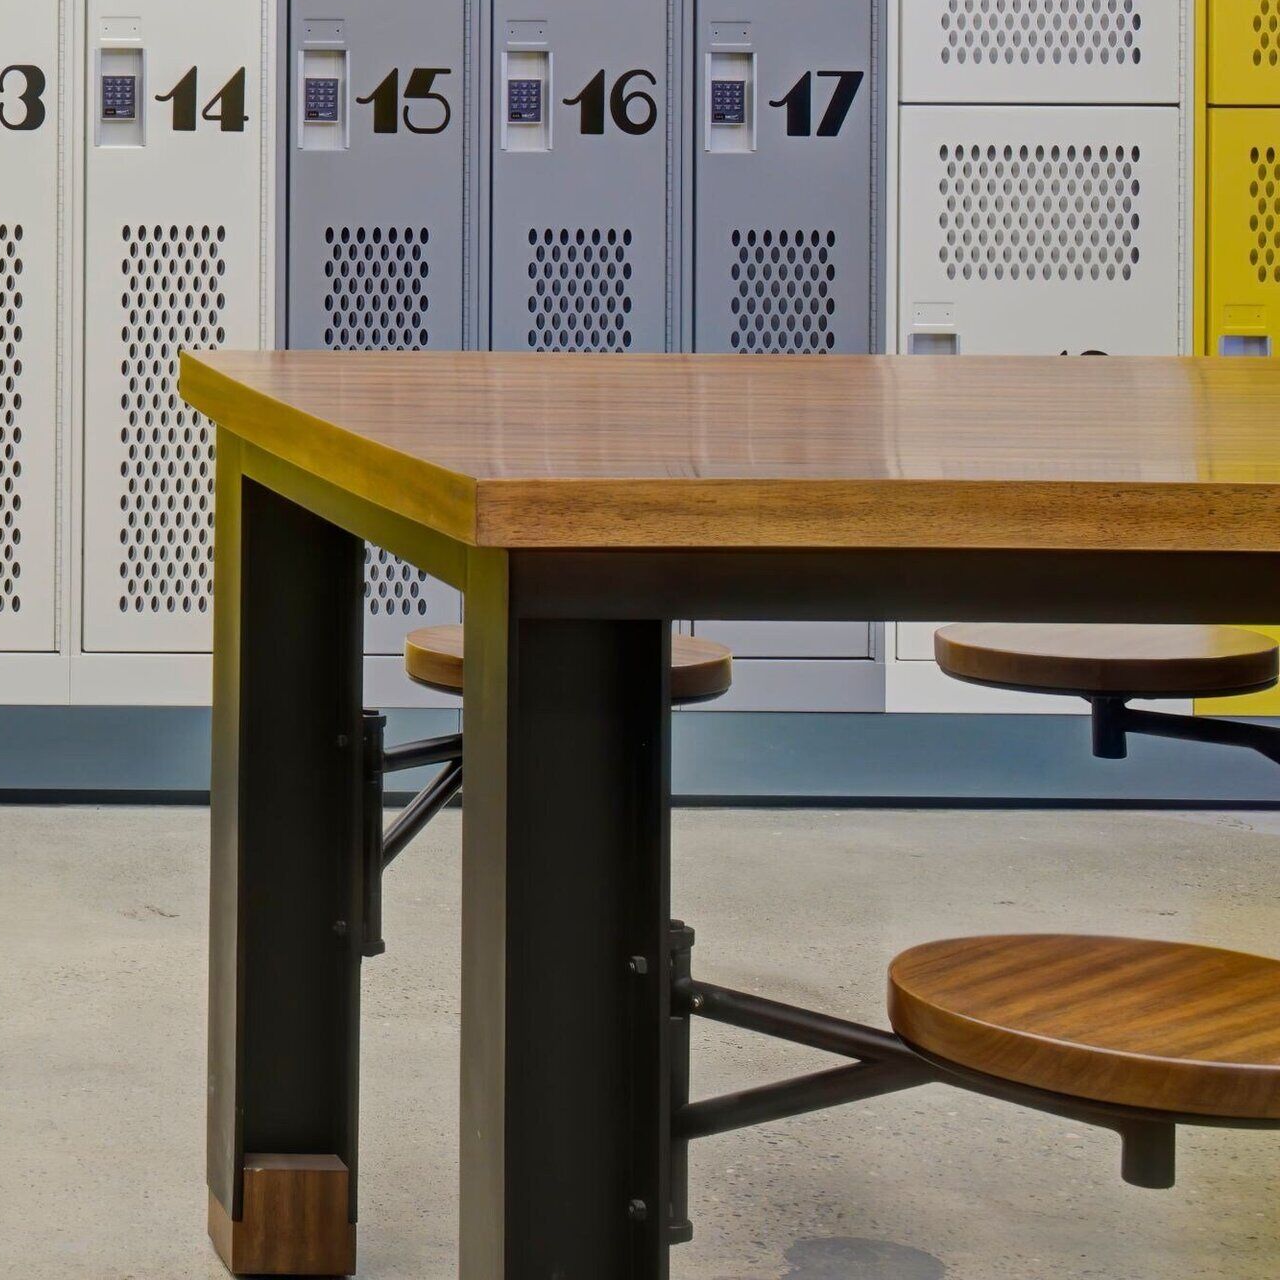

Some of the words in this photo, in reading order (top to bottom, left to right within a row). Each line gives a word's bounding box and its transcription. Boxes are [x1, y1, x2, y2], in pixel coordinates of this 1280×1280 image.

[155, 66, 249, 132] 14
[356, 68, 451, 134] 15
[563, 69, 657, 135] 16
[769, 71, 864, 136] 17
